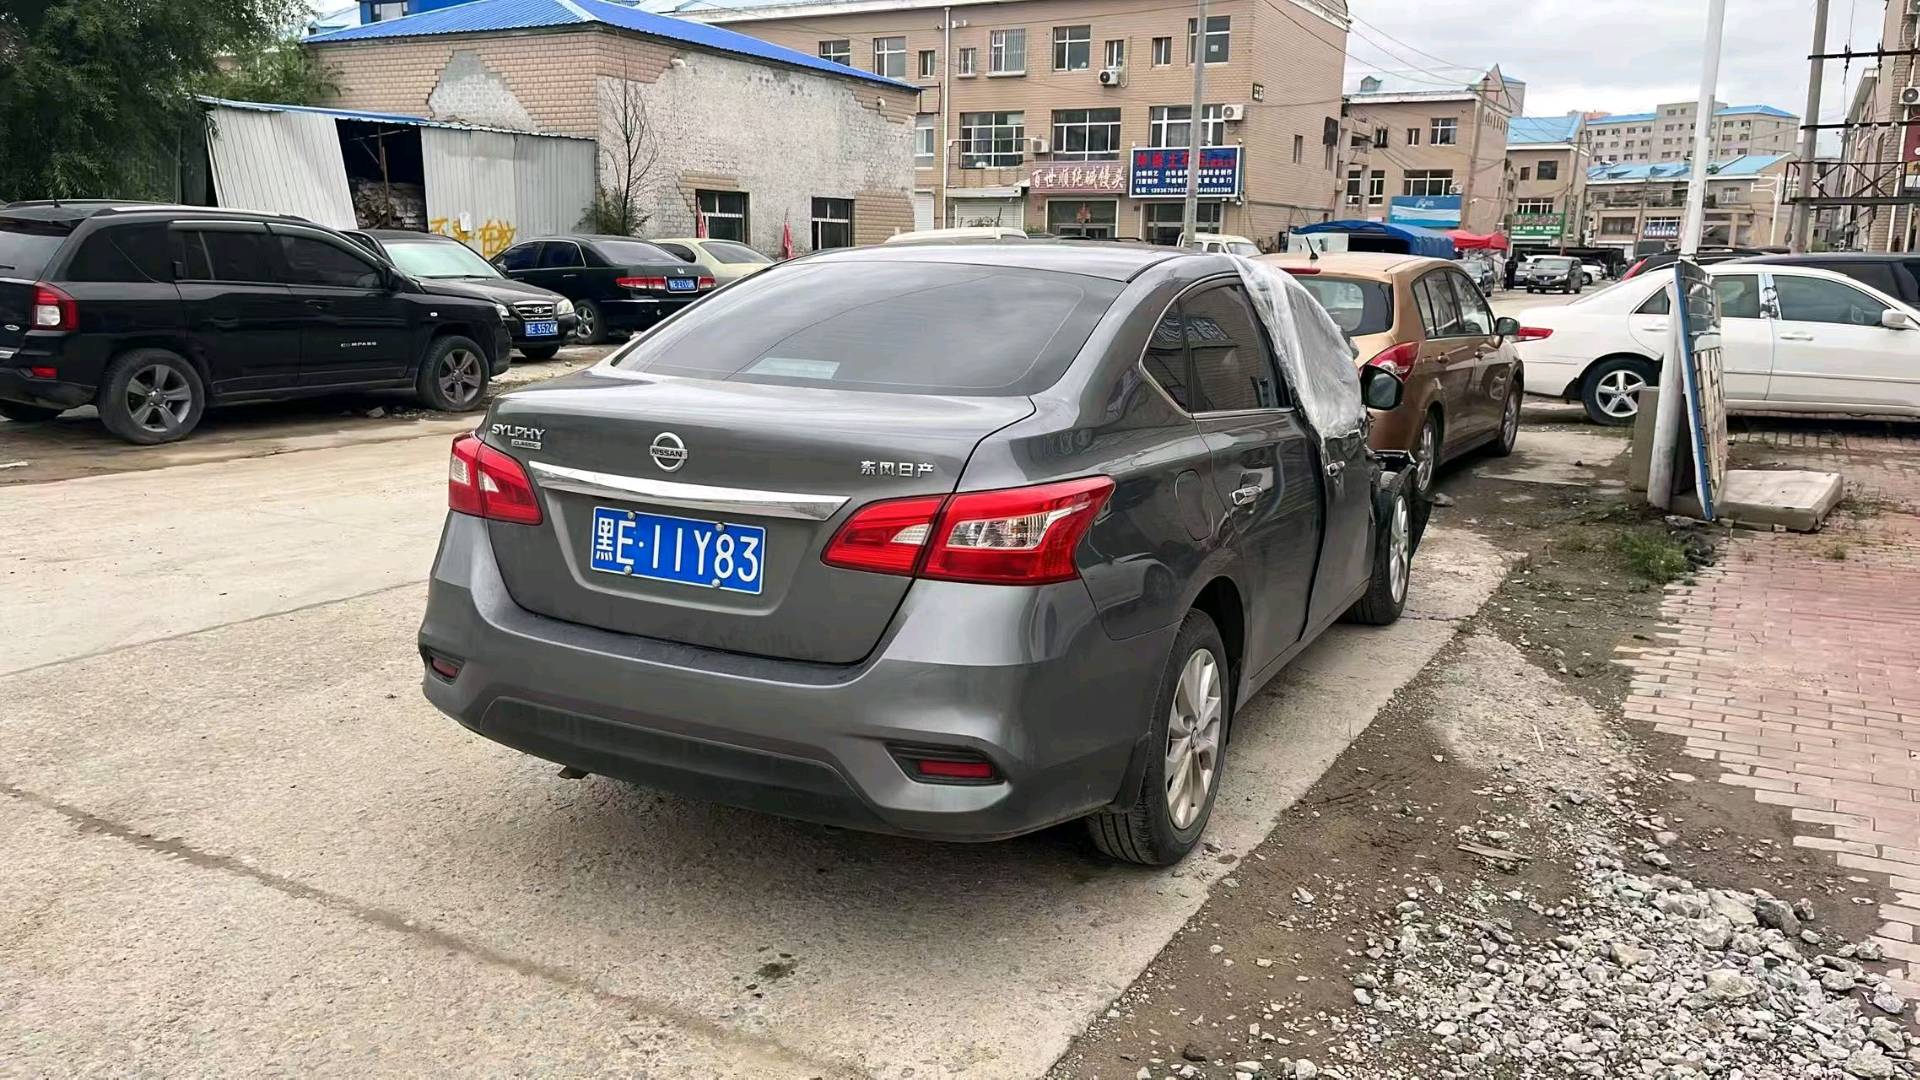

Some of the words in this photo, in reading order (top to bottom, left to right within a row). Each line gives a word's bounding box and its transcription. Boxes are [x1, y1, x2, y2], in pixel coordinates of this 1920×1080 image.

[491, 423, 546, 440] SYLPHY
[651, 447, 683, 458] NISSAN
[860, 460, 934, 478] 东风日产
[595, 516, 760, 583] 黑E·11Y83
